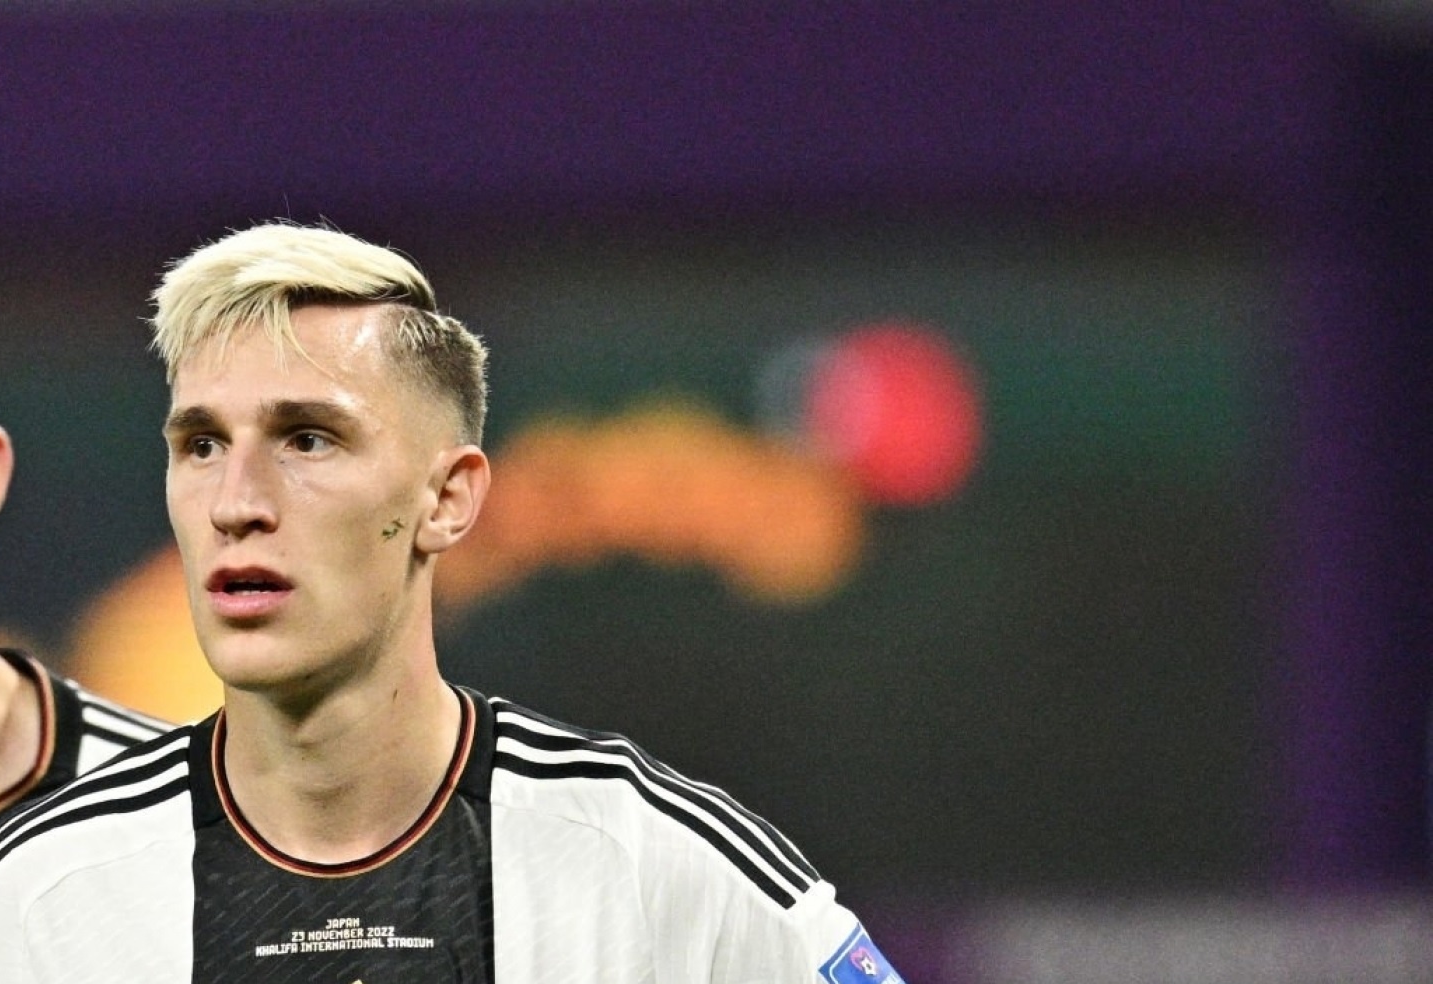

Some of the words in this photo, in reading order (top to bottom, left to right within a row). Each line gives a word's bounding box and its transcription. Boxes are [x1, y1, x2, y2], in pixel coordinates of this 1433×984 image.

[326, 917, 360, 930] JAPAN
[291, 931, 306, 942] 23
[308, 928, 364, 941] NOVEMBER
[367, 926, 395, 937] 2022
[256, 943, 298, 957] KHALIFA
[300, 938, 385, 953] INTERNATIONAL
[386, 937, 434, 949] STADIUM
